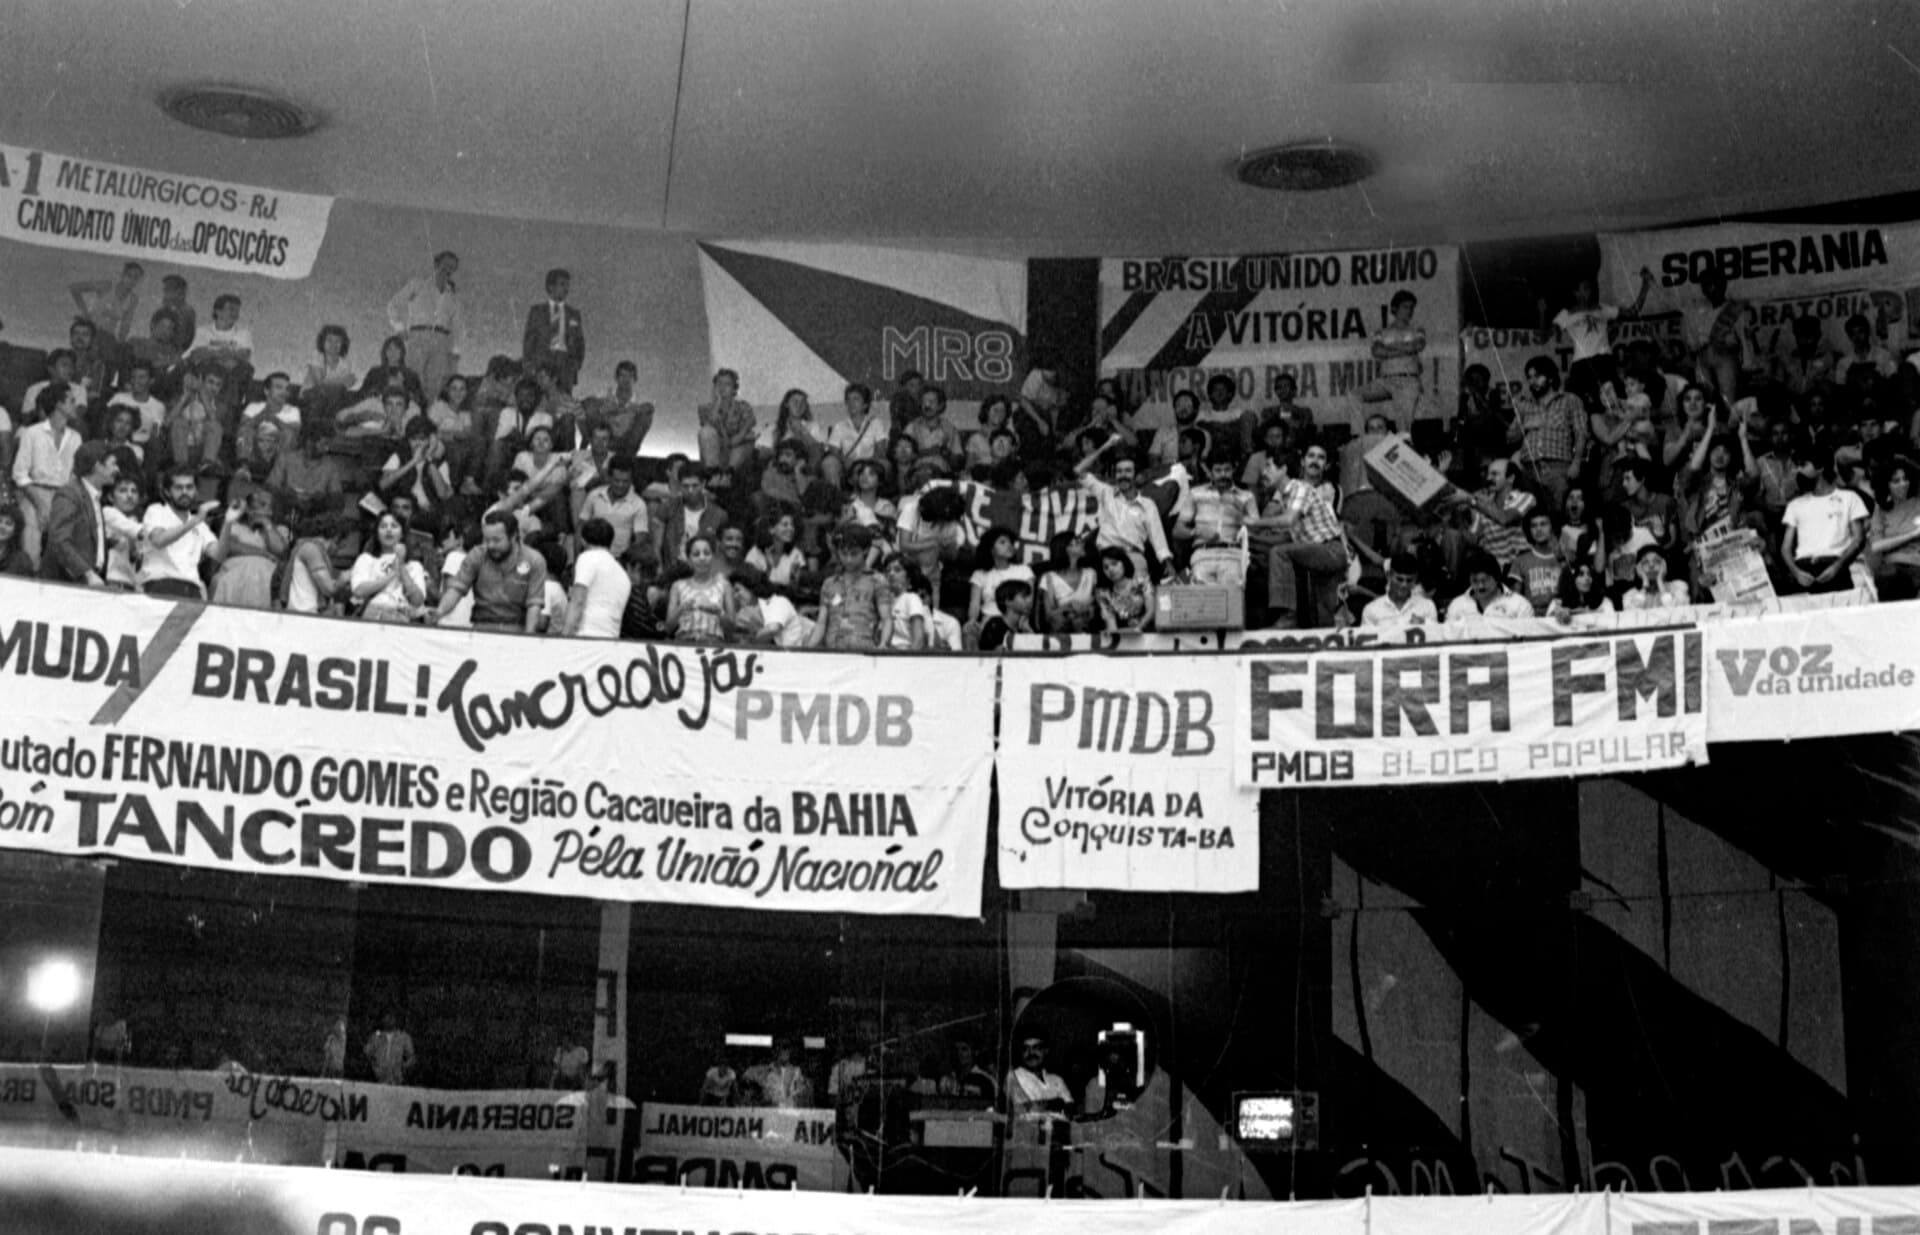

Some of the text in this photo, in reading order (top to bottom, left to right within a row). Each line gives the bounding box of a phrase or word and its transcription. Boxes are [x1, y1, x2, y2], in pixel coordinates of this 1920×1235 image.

[17, 198, 289, 266] CANDIDATO ÚNICO das OPOSIÇÕES
[1661, 229, 1888, 287] SOBERANIA
[1122, 249, 1438, 292] BRASIL UNIDO RUMO
[882, 326, 1013, 382] MR8
[1186, 311, 1216, 349] A
[1117, 366, 1254, 405] TANCRO
[0, 619, 142, 689] MUDA
[1756, 662, 1915, 696] da unidade
[1250, 631, 1702, 740] FORA FMI
[734, 689, 915, 748] PMDB
[102, 734, 303, 798] FERNANDO
[311, 756, 440, 809] GOMES
[445, 783, 465, 812] e
[469, 769, 577, 823] Região
[585, 782, 733, 830] Cacaueira
[744, 797, 781, 834] da
[792, 791, 918, 837] BAHIA
[1251, 731, 1686, 783] PMDB BLOCO POPULAR
[1165, 791, 1203, 819] DA
[64, 790, 533, 883] TANCREDO
